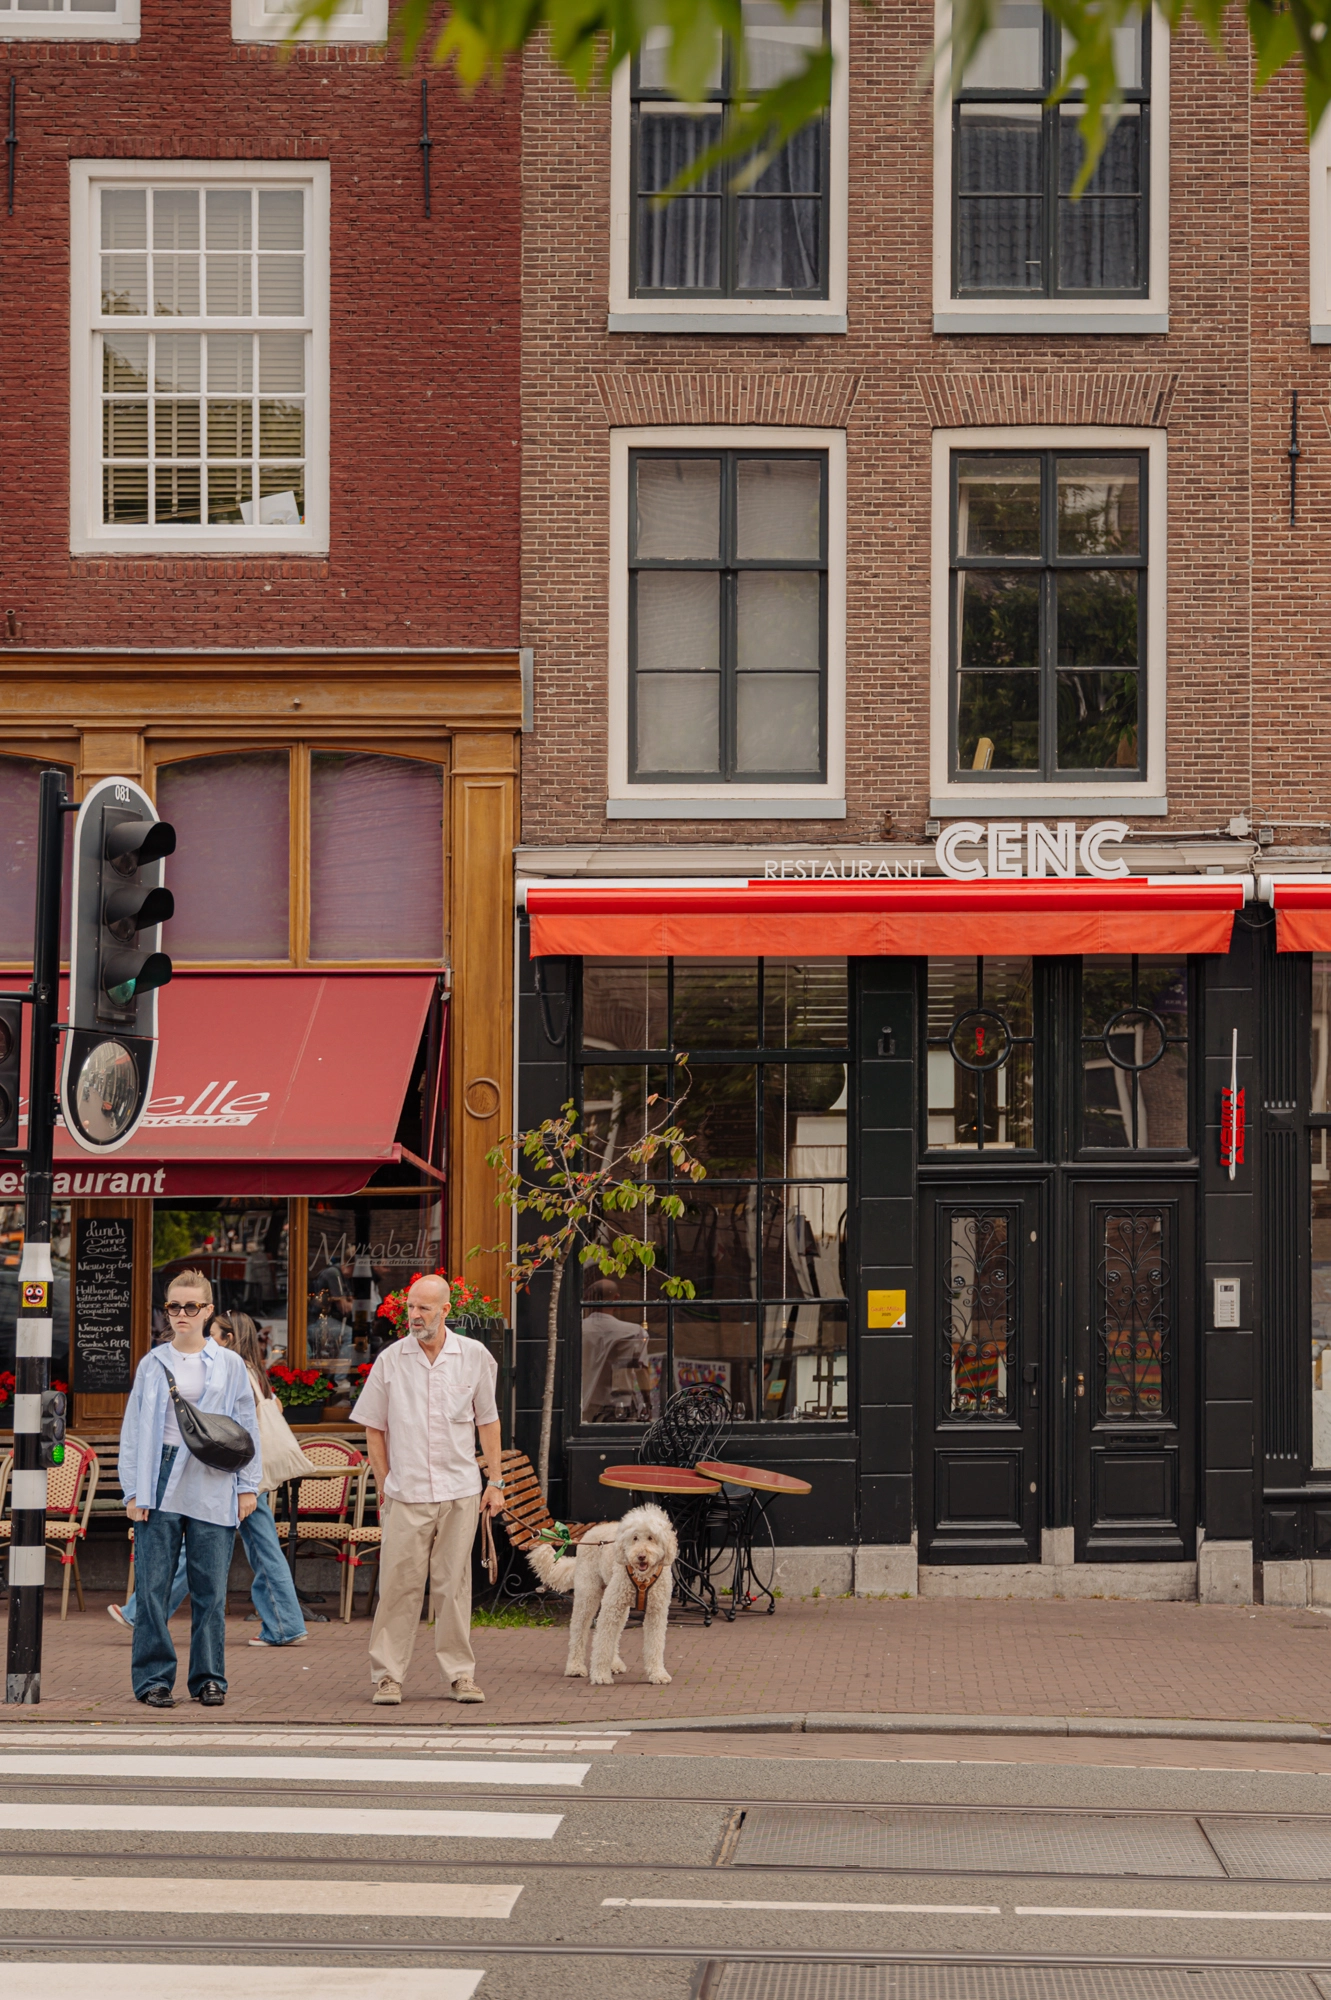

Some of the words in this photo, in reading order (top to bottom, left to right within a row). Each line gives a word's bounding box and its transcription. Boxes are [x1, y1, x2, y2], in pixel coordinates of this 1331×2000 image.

[115, 785, 130, 802] 081
[935, 820, 1131, 880] CENC
[764, 859, 925, 879] RESTAURANT
[86, 1221, 125, 1236] Lunch
[83, 1236, 127, 1246] Dinner
[86, 1245, 127, 1254] Snacks
[308, 1229, 439, 1272] Myrabelle
